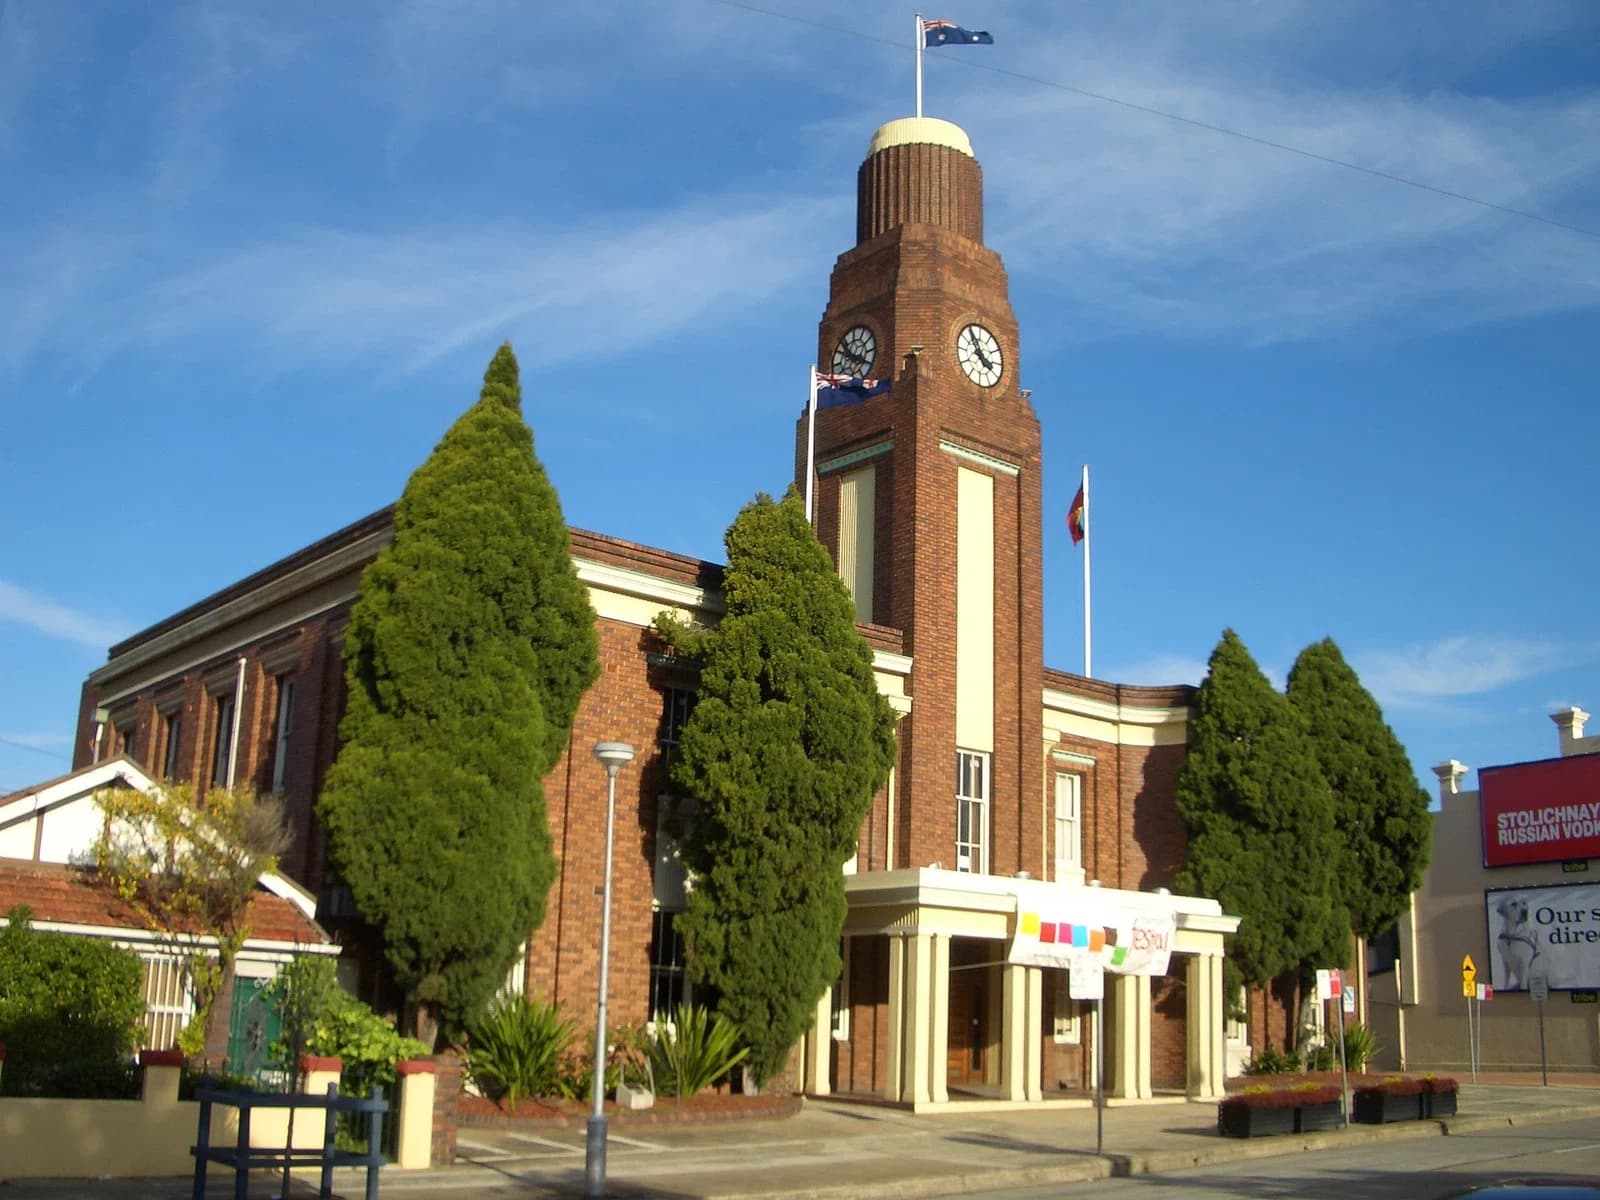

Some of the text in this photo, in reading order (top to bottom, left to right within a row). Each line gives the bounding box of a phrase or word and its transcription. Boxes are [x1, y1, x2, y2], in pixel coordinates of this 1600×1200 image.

[1497, 803, 1600, 829] STOLICHNAY
[1498, 823, 1560, 845] RUSSIAN
[1535, 907, 1586, 925] Our
[1549, 926, 1600, 944] dire
